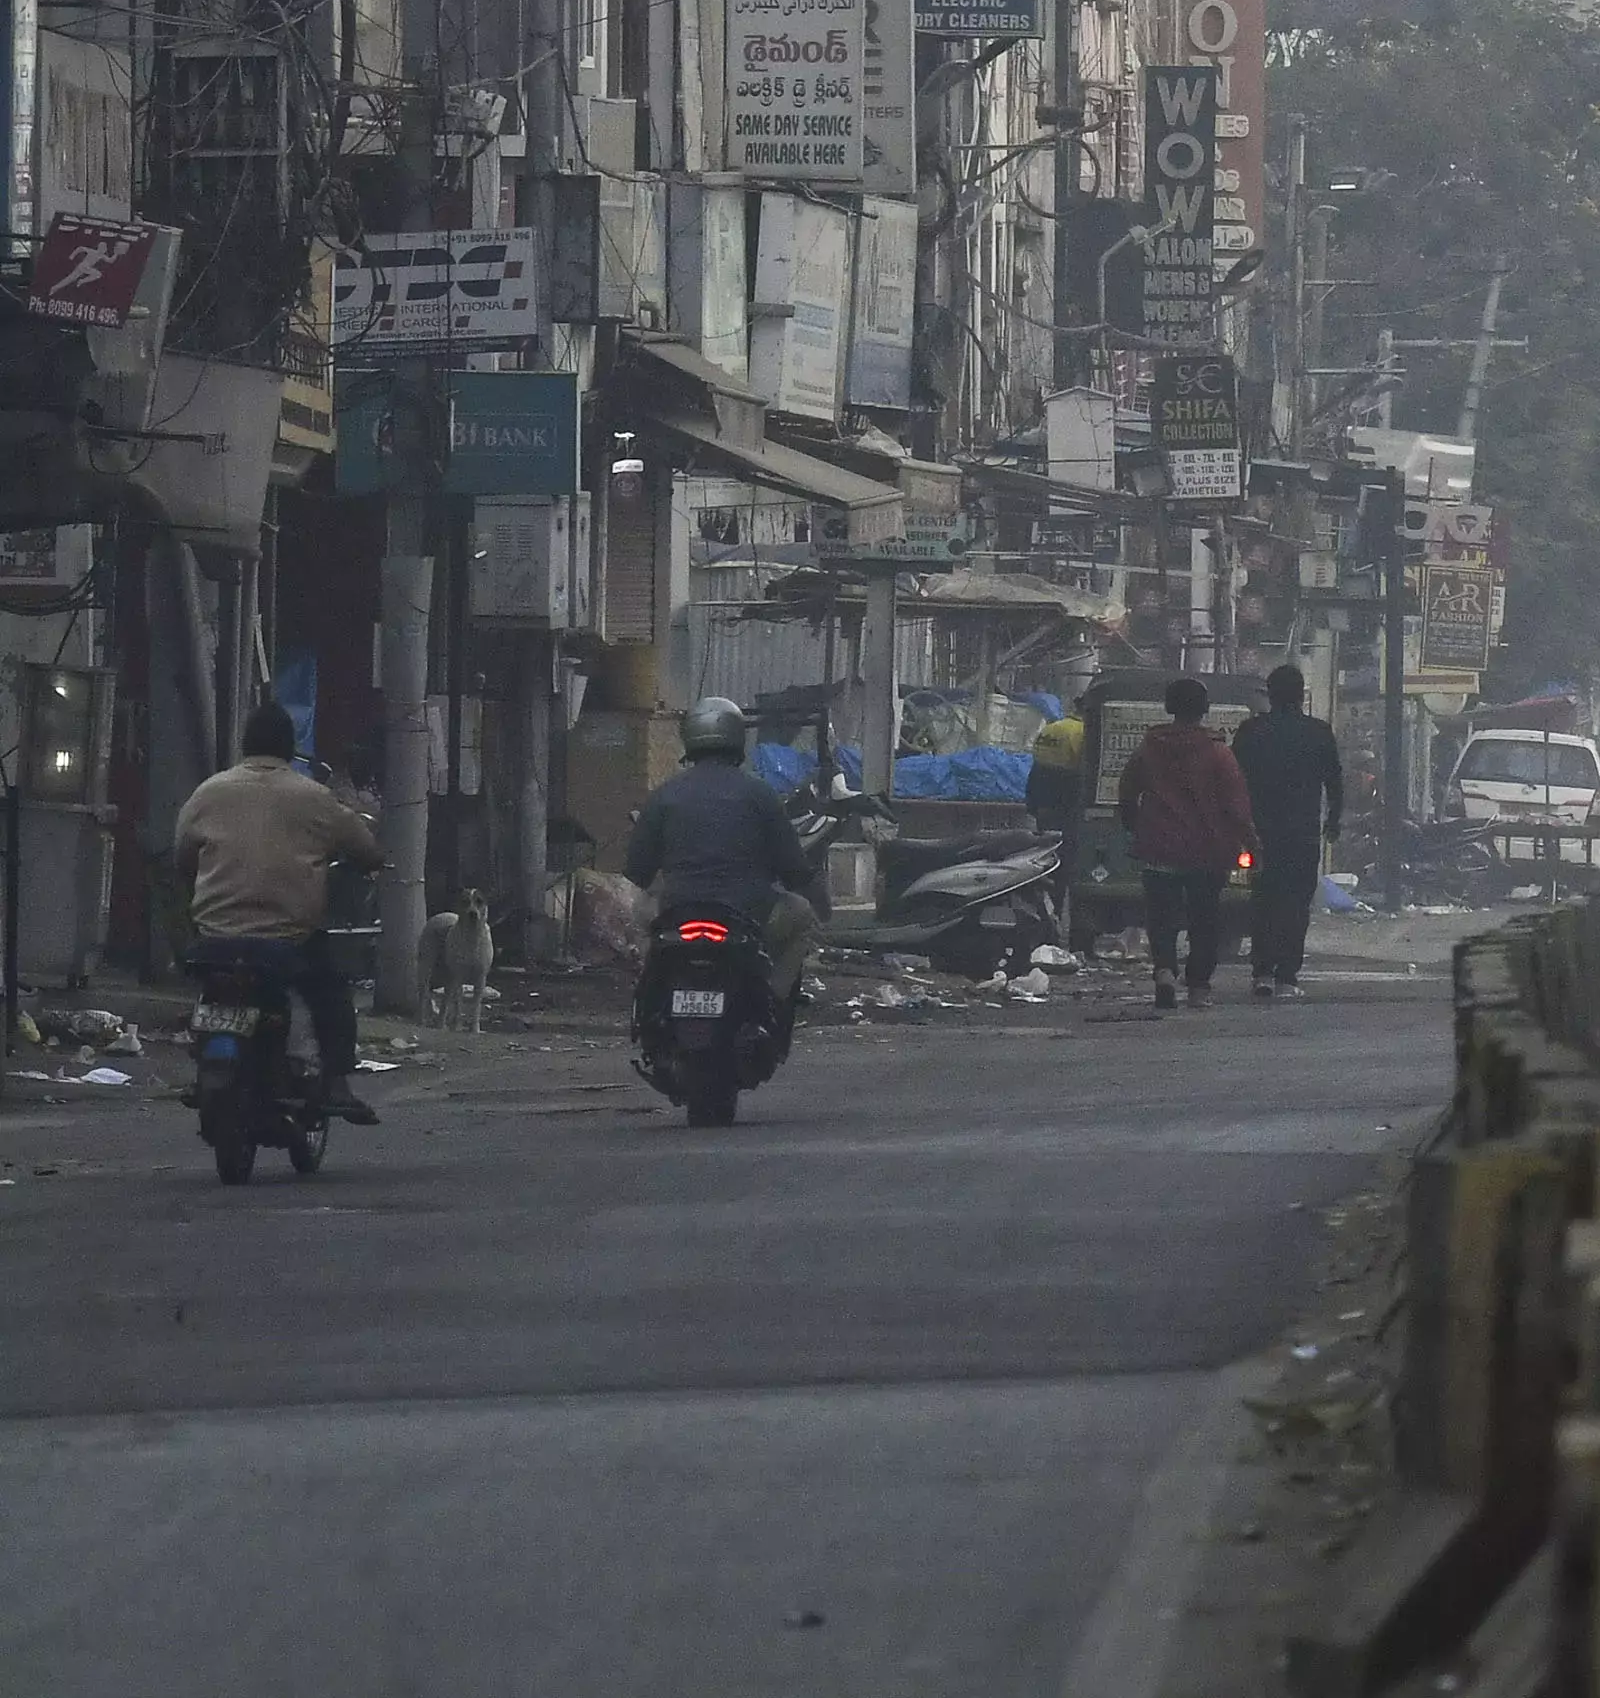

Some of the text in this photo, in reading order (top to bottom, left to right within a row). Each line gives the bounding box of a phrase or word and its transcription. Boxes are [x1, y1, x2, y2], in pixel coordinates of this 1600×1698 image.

[914, 12, 1031, 29] DRY CLEANERS
[735, 114, 853, 137] SAME DAY SERVICE
[744, 142, 846, 165] AVAILABLE HERE
[1143, 237, 1213, 266] SALON
[28, 295, 46, 314] Ph:
[48, 298, 75, 317] 8099
[75, 302, 96, 322] 416
[400, 301, 509, 316] INTERNATIONAL
[401, 316, 451, 330] CARGO
[1162, 399, 1231, 420] SHIFA
[483, 425, 548, 448] BANK
[1162, 422, 1233, 440] COLLECTION
[1213, 475, 1237, 485] SIZE
[1430, 612, 1485, 624] FASHION
